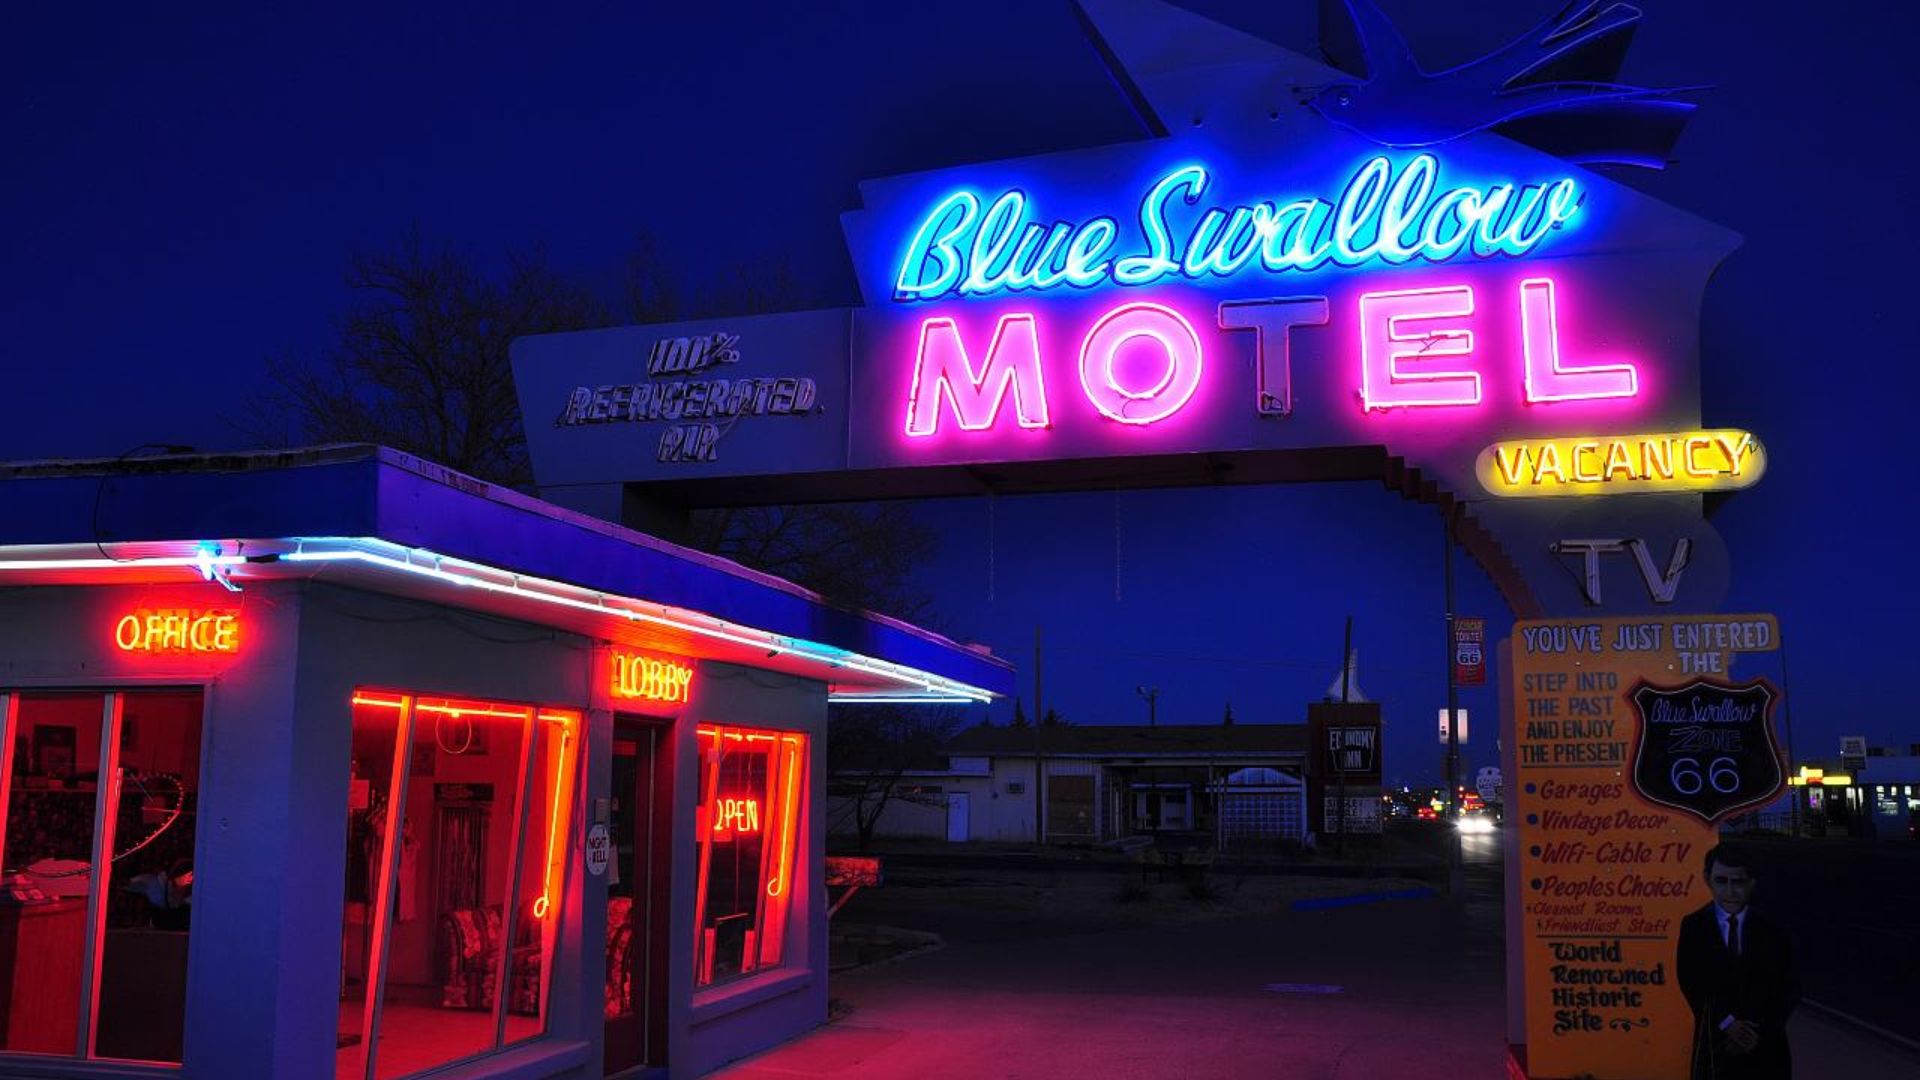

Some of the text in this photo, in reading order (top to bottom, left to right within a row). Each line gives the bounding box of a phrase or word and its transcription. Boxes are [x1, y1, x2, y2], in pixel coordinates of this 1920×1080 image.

[894, 154, 1582, 301] Blue Swallow
[648, 333, 741, 377] 100%
[906, 278, 1638, 436] MOTEL
[565, 377, 817, 425] REFRIGERATED
[657, 422, 719, 463] AIR
[1496, 433, 1752, 485] VACANCY
[1557, 537, 1692, 605] TV
[115, 611, 238, 653] OFFICE
[1523, 621, 1771, 653] YOU'VE JUST ENTERED
[1460, 653, 1479, 664] 66
[1679, 652, 1722, 673] THE
[614, 654, 693, 703] LOBBY
[1523, 671, 1618, 693] STEP INTO
[1527, 696, 1614, 716] THE PAST
[1652, 695, 1756, 722] Blue Swallow
[1526, 719, 1615, 740] AND ENJOY
[1669, 726, 1743, 752] ZONE
[1520, 742, 1628, 764] THE PRESENT
[1671, 757, 1740, 794] 66
[1540, 779, 1623, 805] Garages
[1541, 809, 1669, 836] Vintage Decor
[1658, 842, 1691, 864] TV
[1541, 874, 1694, 900] Peoples Choice!
[1533, 902, 1643, 916] Cleanest Rooms
[1544, 918, 1670, 933] Friendliest Staff
[1549, 940, 1622, 962] World
[1550, 962, 1665, 985] Renowned
[1551, 986, 1643, 1009] Historic
[1553, 1010, 1603, 1036] Site
